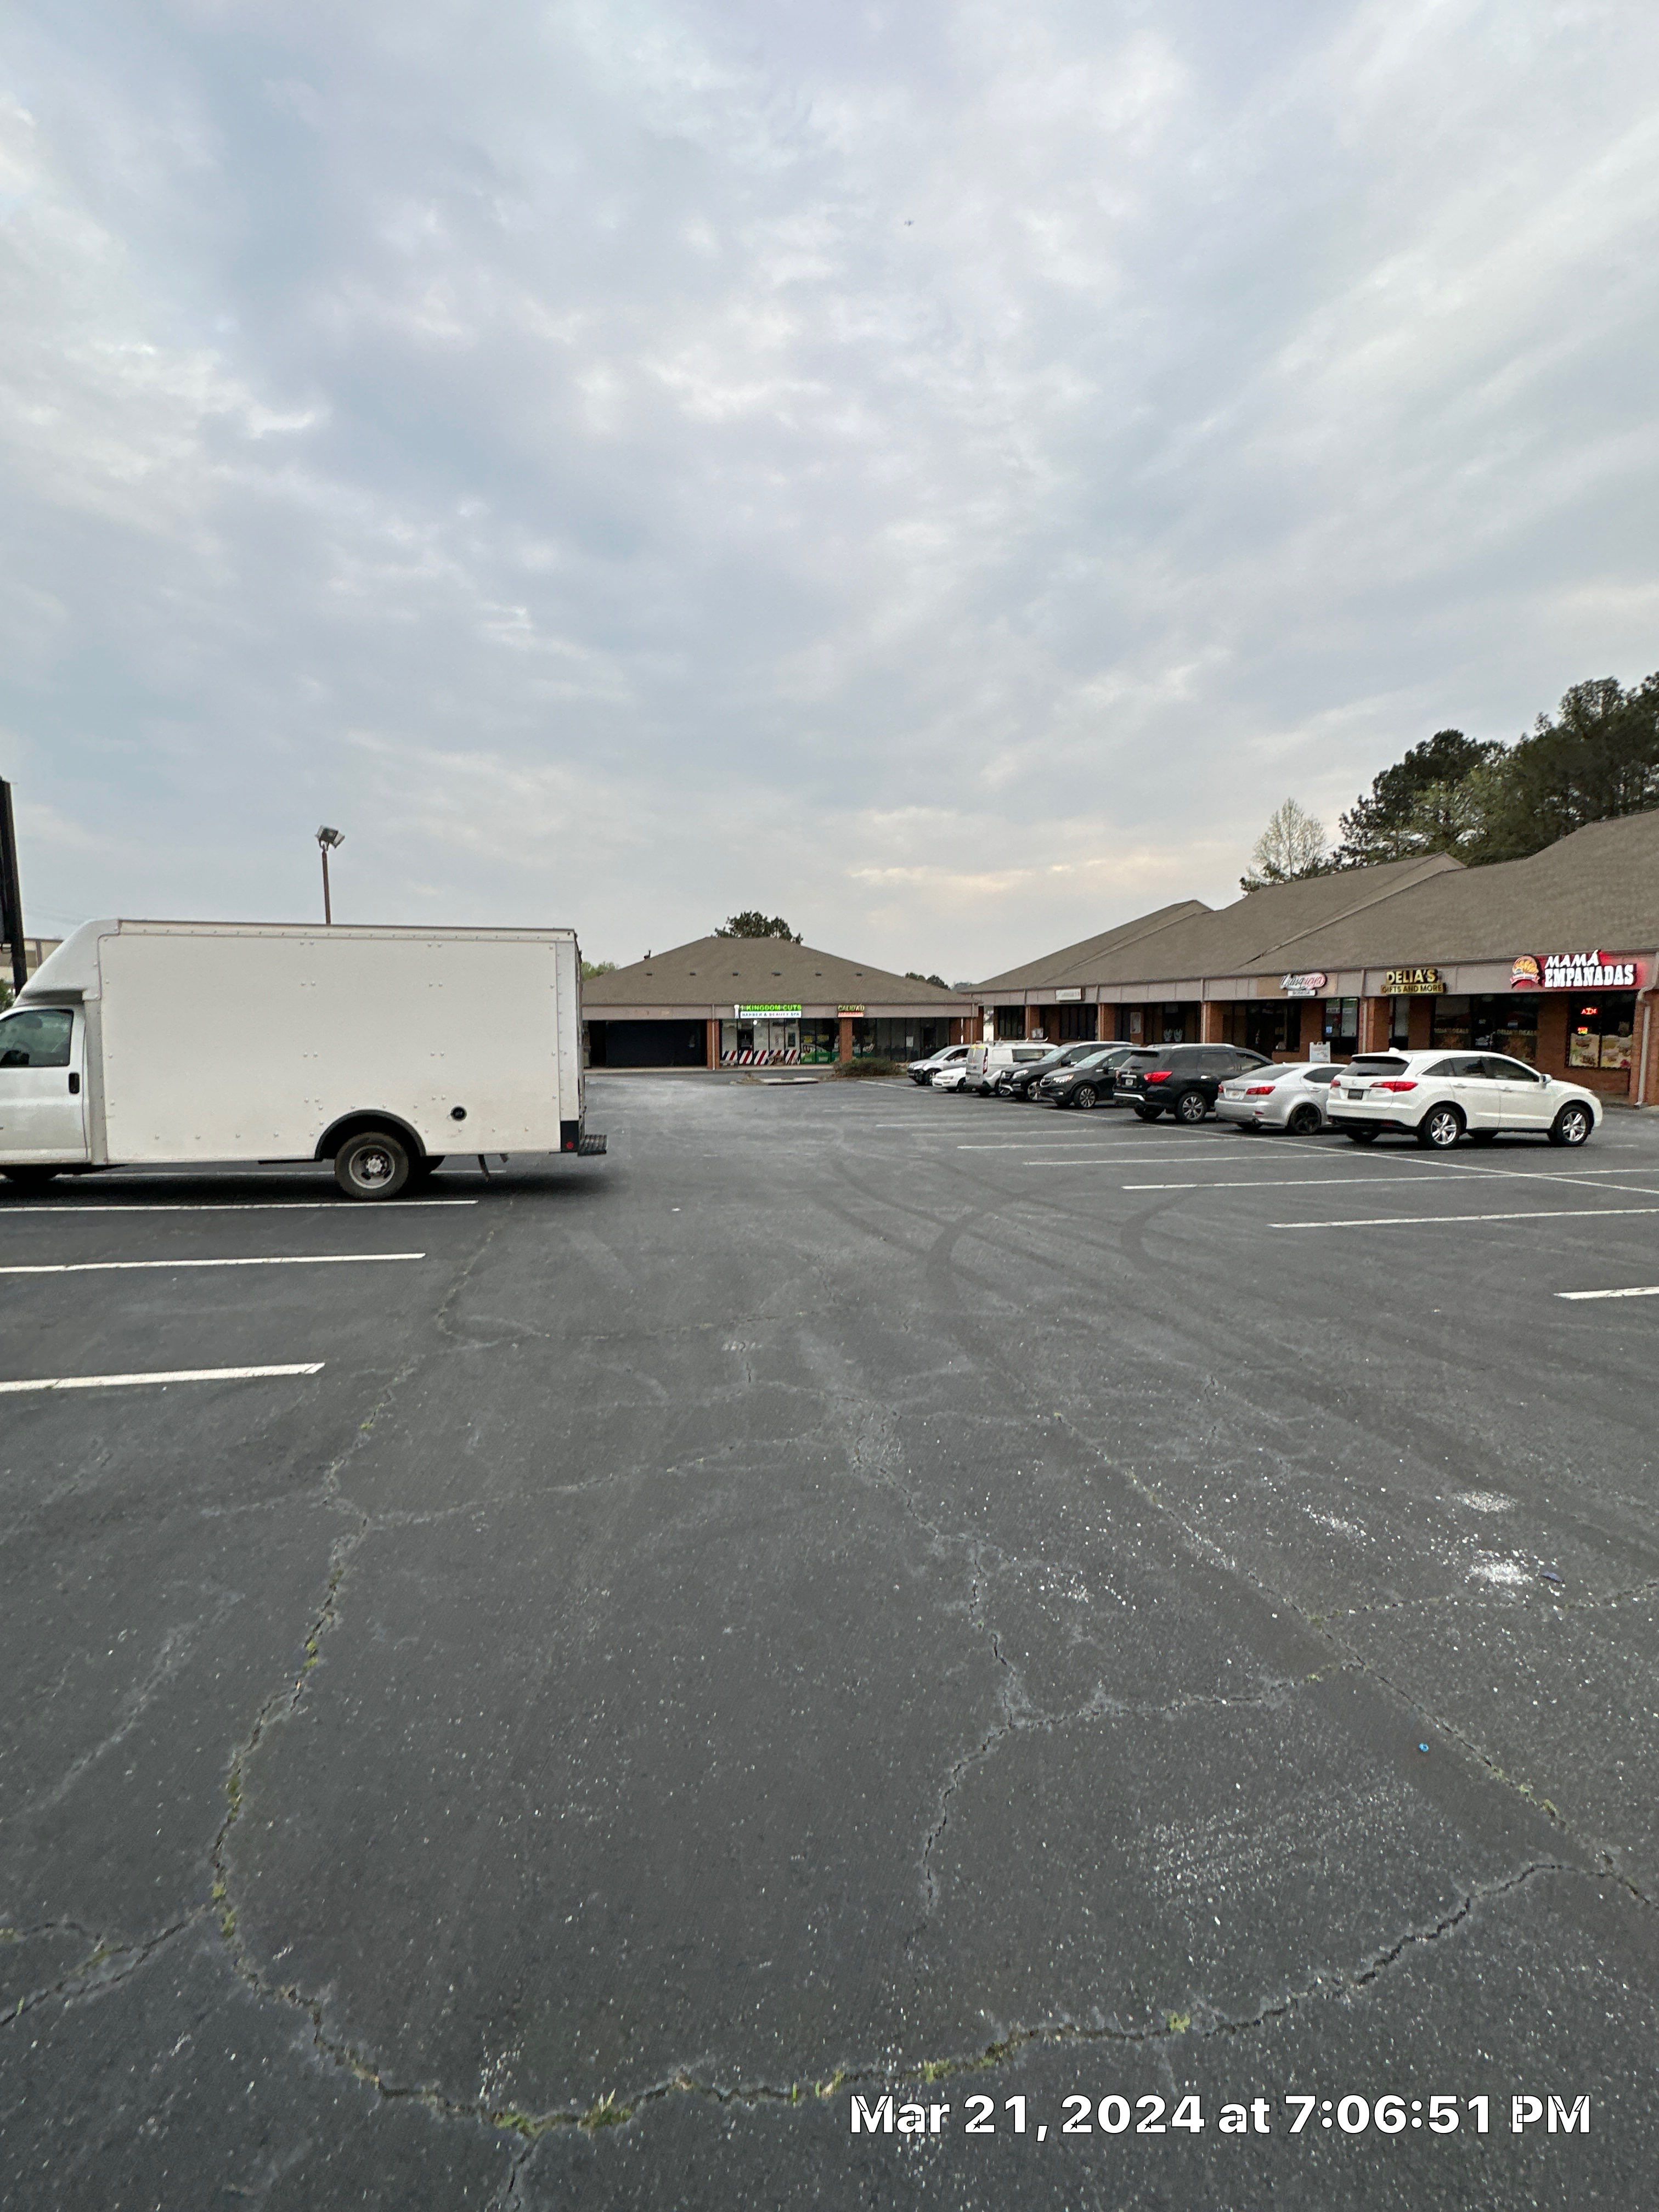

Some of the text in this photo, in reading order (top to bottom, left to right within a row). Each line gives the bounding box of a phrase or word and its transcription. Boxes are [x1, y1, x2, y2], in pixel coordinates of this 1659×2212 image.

[1544, 950, 1600, 969] MAMÁ
[1386, 969, 1436, 984] DELIA'S
[1544, 964, 1634, 988] EMPANADAS
